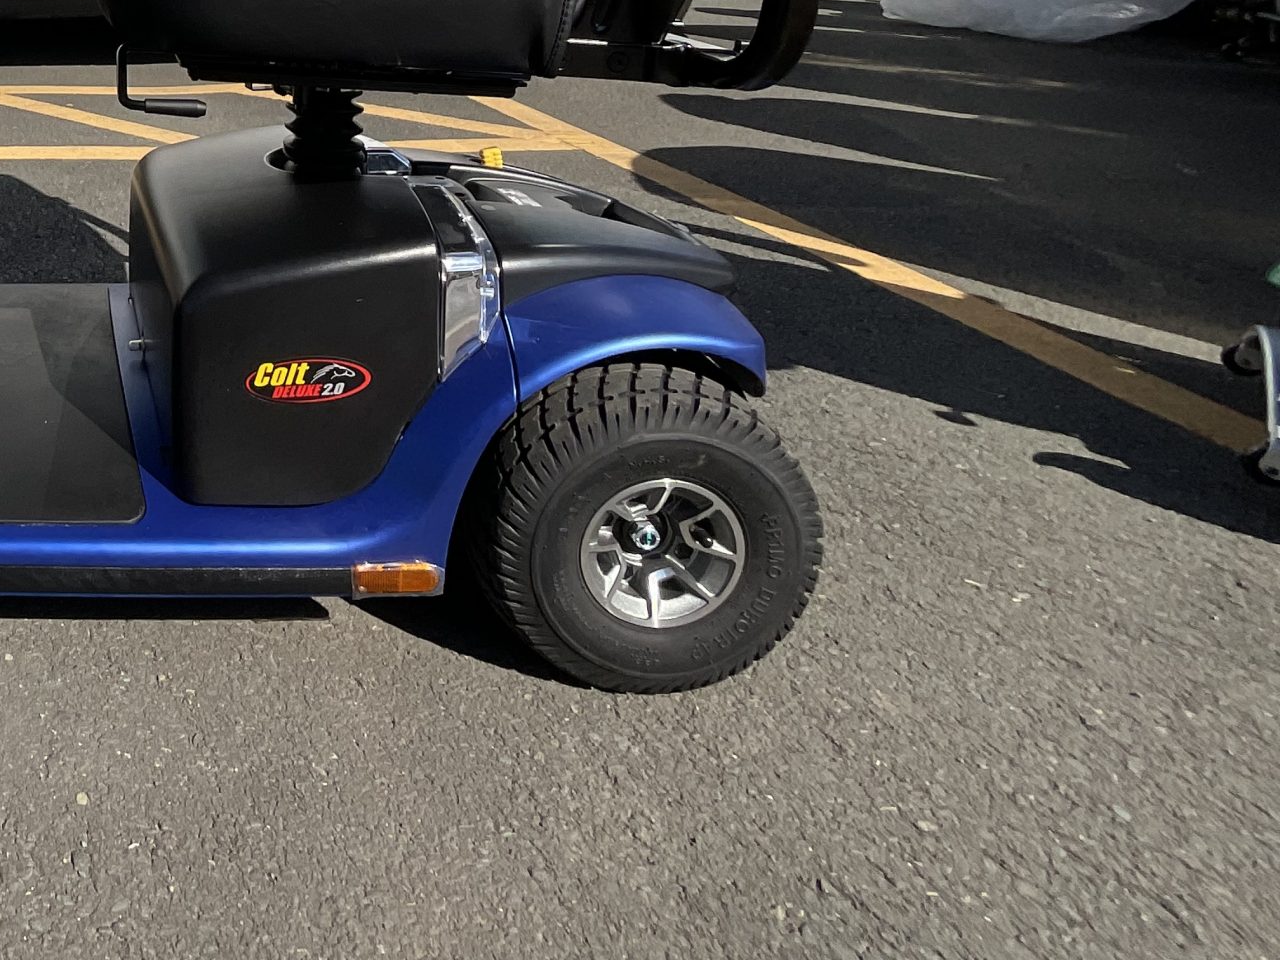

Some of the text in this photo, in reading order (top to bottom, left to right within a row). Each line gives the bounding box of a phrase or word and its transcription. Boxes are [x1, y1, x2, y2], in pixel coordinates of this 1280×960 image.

[254, 362, 310, 387] Colt
[271, 382, 346, 398] DELUXE 2.0
